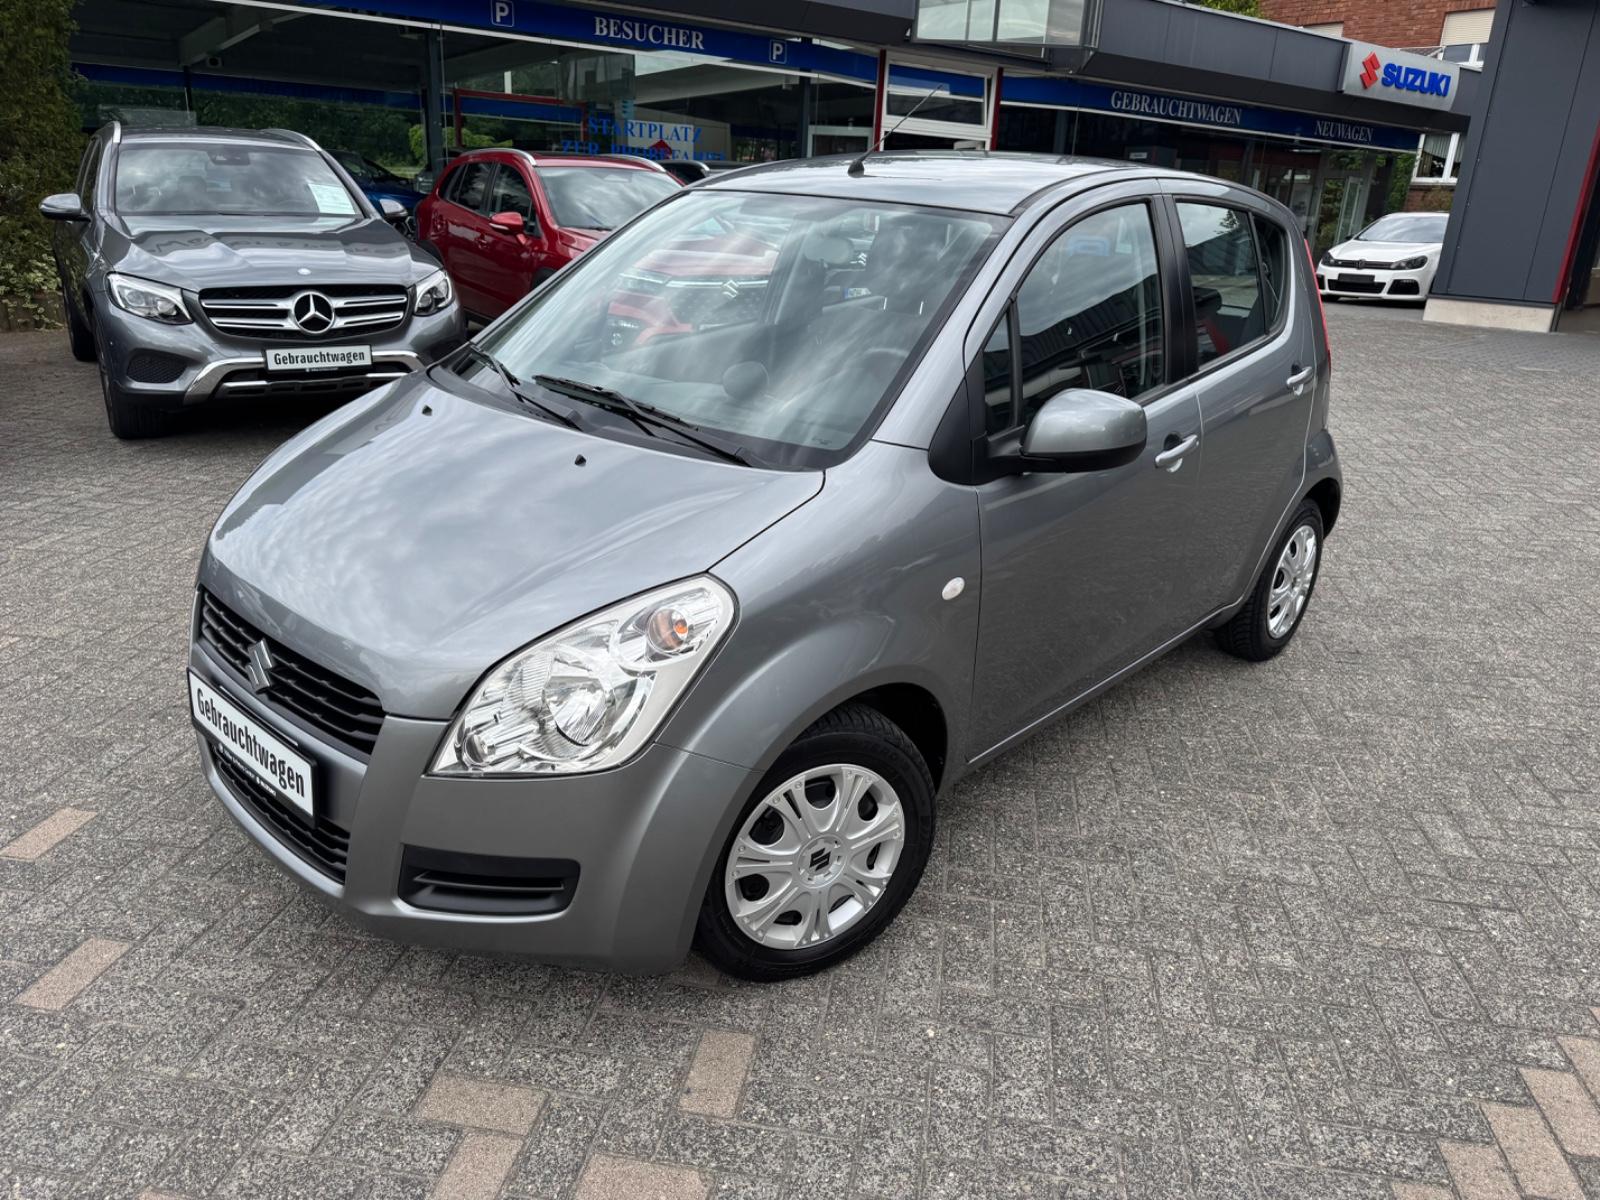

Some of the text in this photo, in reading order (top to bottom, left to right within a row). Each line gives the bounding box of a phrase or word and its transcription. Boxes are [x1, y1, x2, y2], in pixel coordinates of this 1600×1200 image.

[594, 16, 704, 49] BESUCHER
[1381, 63, 1451, 97] SUZUKI
[1110, 90, 1242, 126] GEBRAUCHTWAGEN
[588, 115, 703, 144] STARTPLATZ
[1314, 120, 1375, 142] NEUWAGEN
[274, 351, 365, 365] Gebrauchtwagen
[196, 687, 305, 798] Gebrauchtwagen
